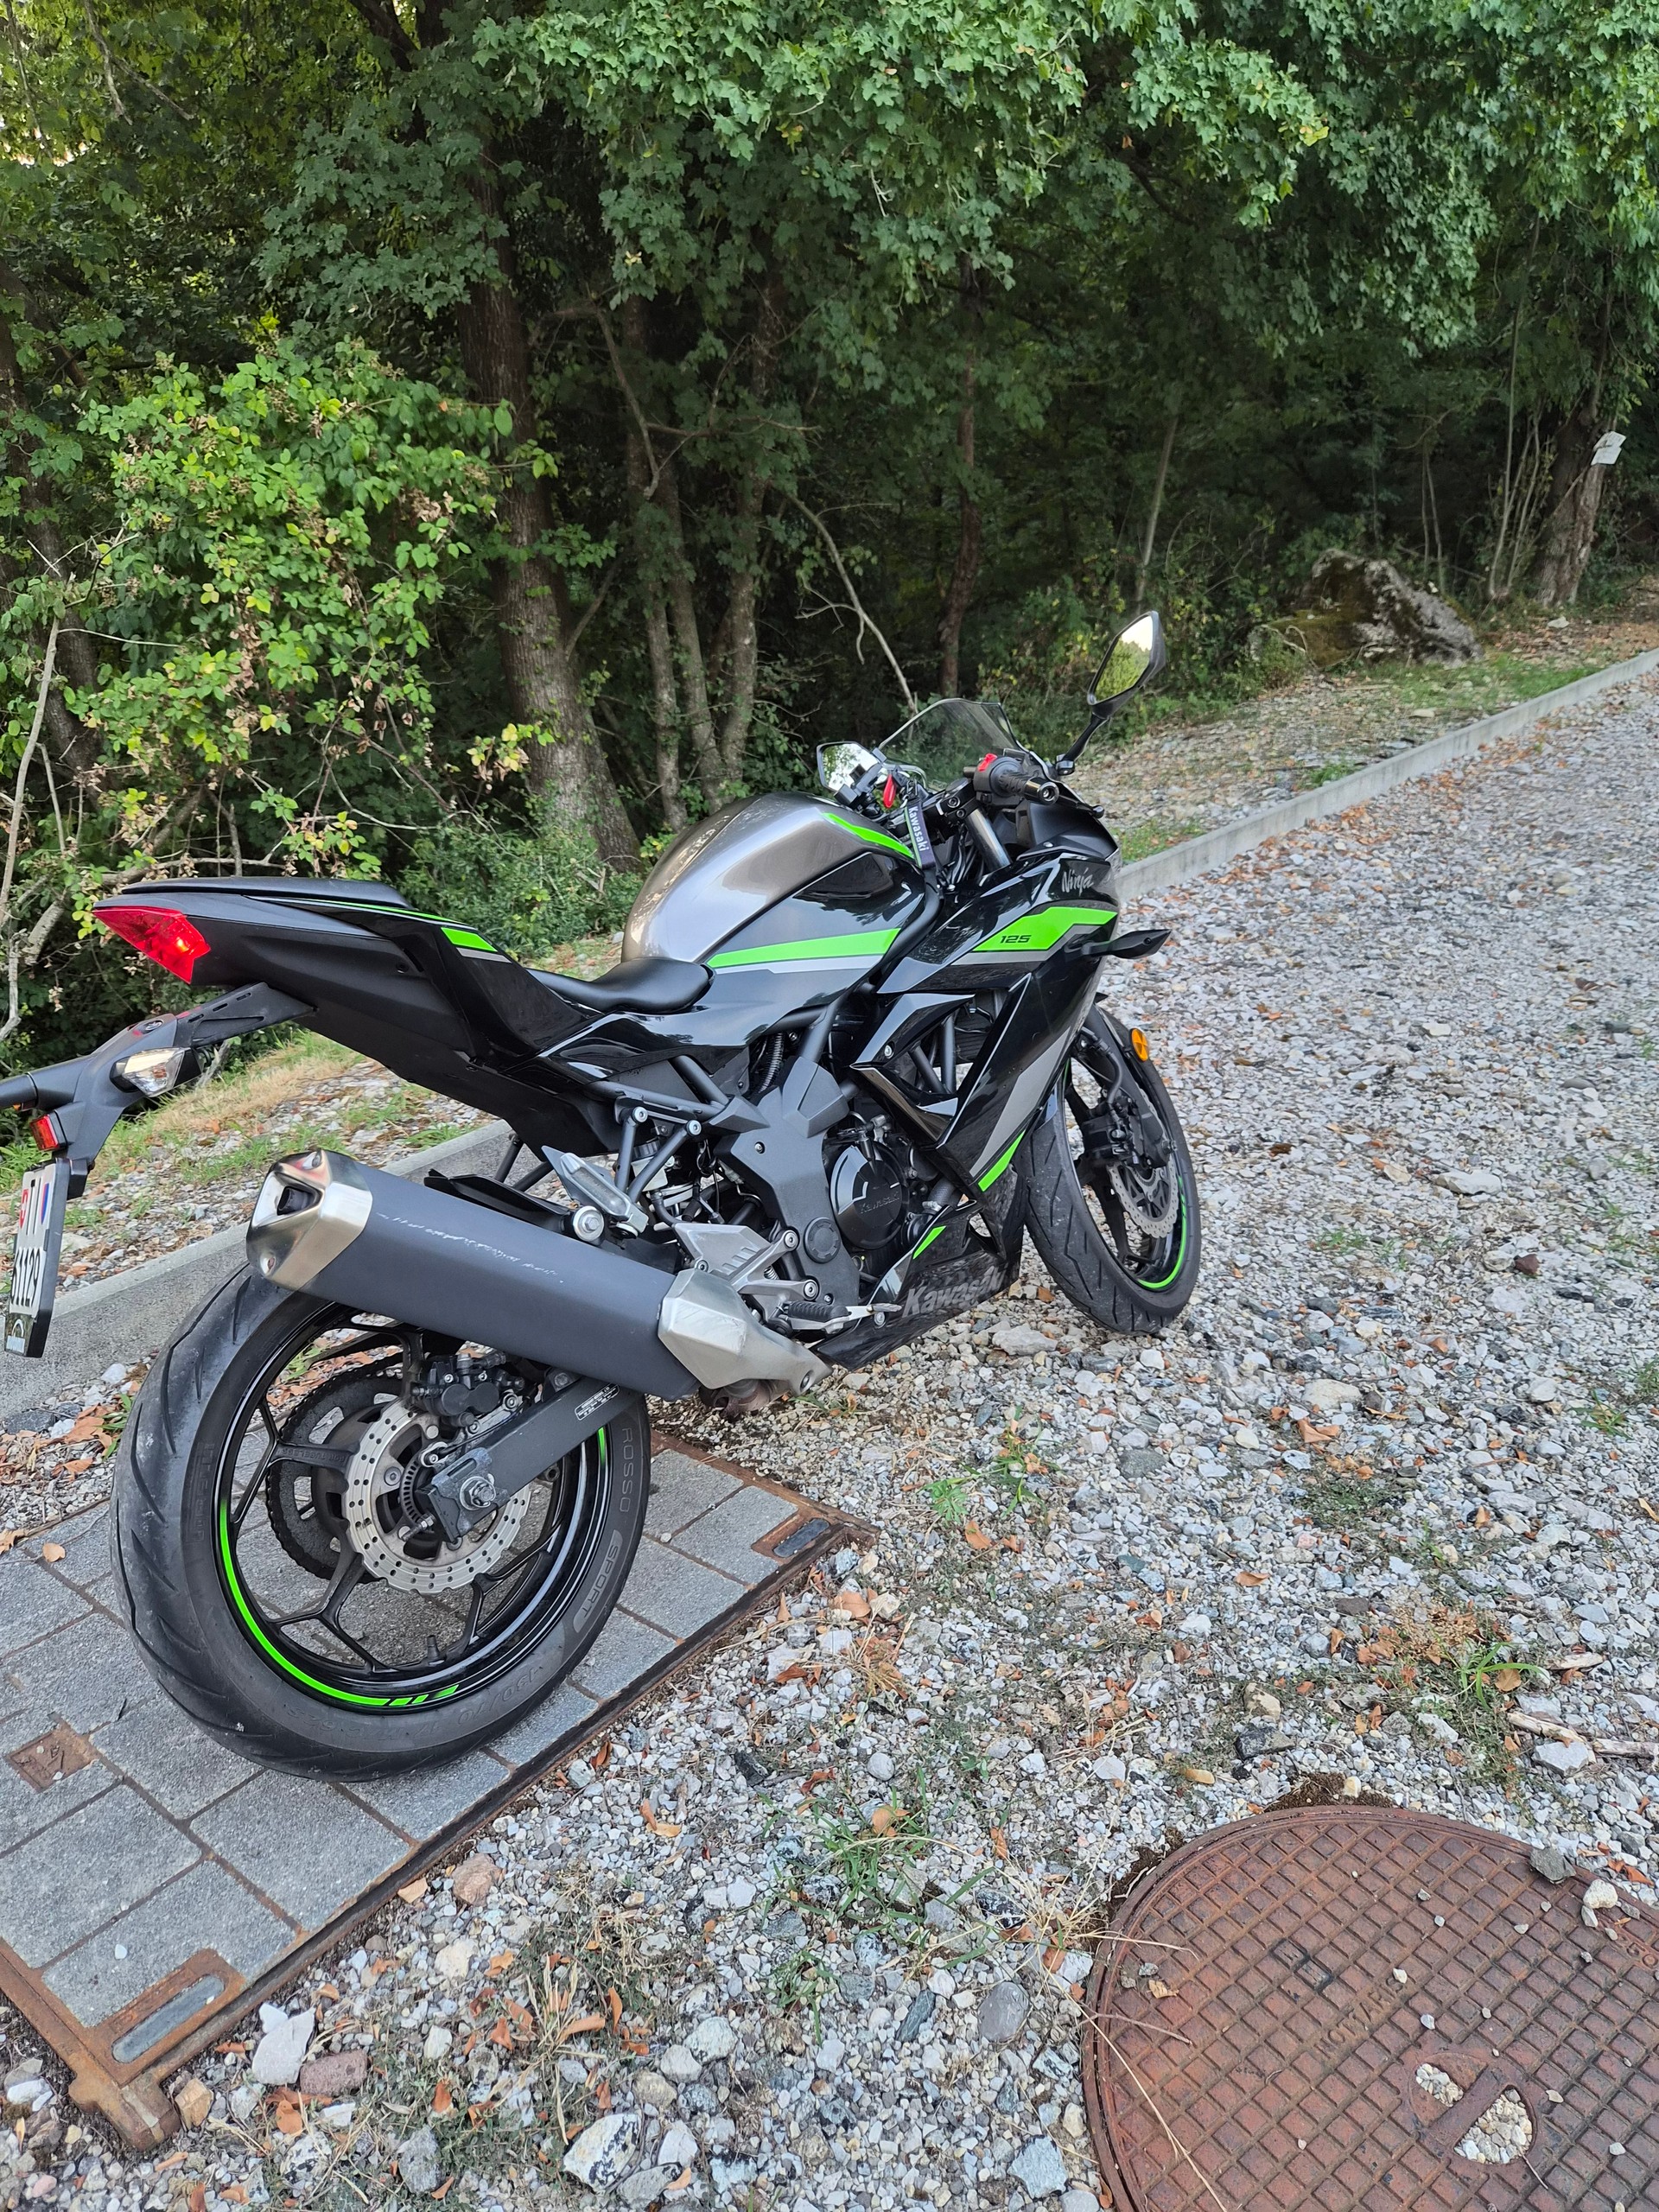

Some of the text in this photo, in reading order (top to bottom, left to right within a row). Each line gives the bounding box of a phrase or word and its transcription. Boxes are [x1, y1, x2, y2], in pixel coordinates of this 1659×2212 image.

[907, 805, 931, 852] Kawasaki
[1061, 868, 1095, 897] Ninja
[1000, 934, 1031, 944] 125
[26, 1177, 41, 1236] TI
[902, 1263, 1008, 1319] Kawasaki
[582, 1427, 634, 1618] ROSSO SPORT
